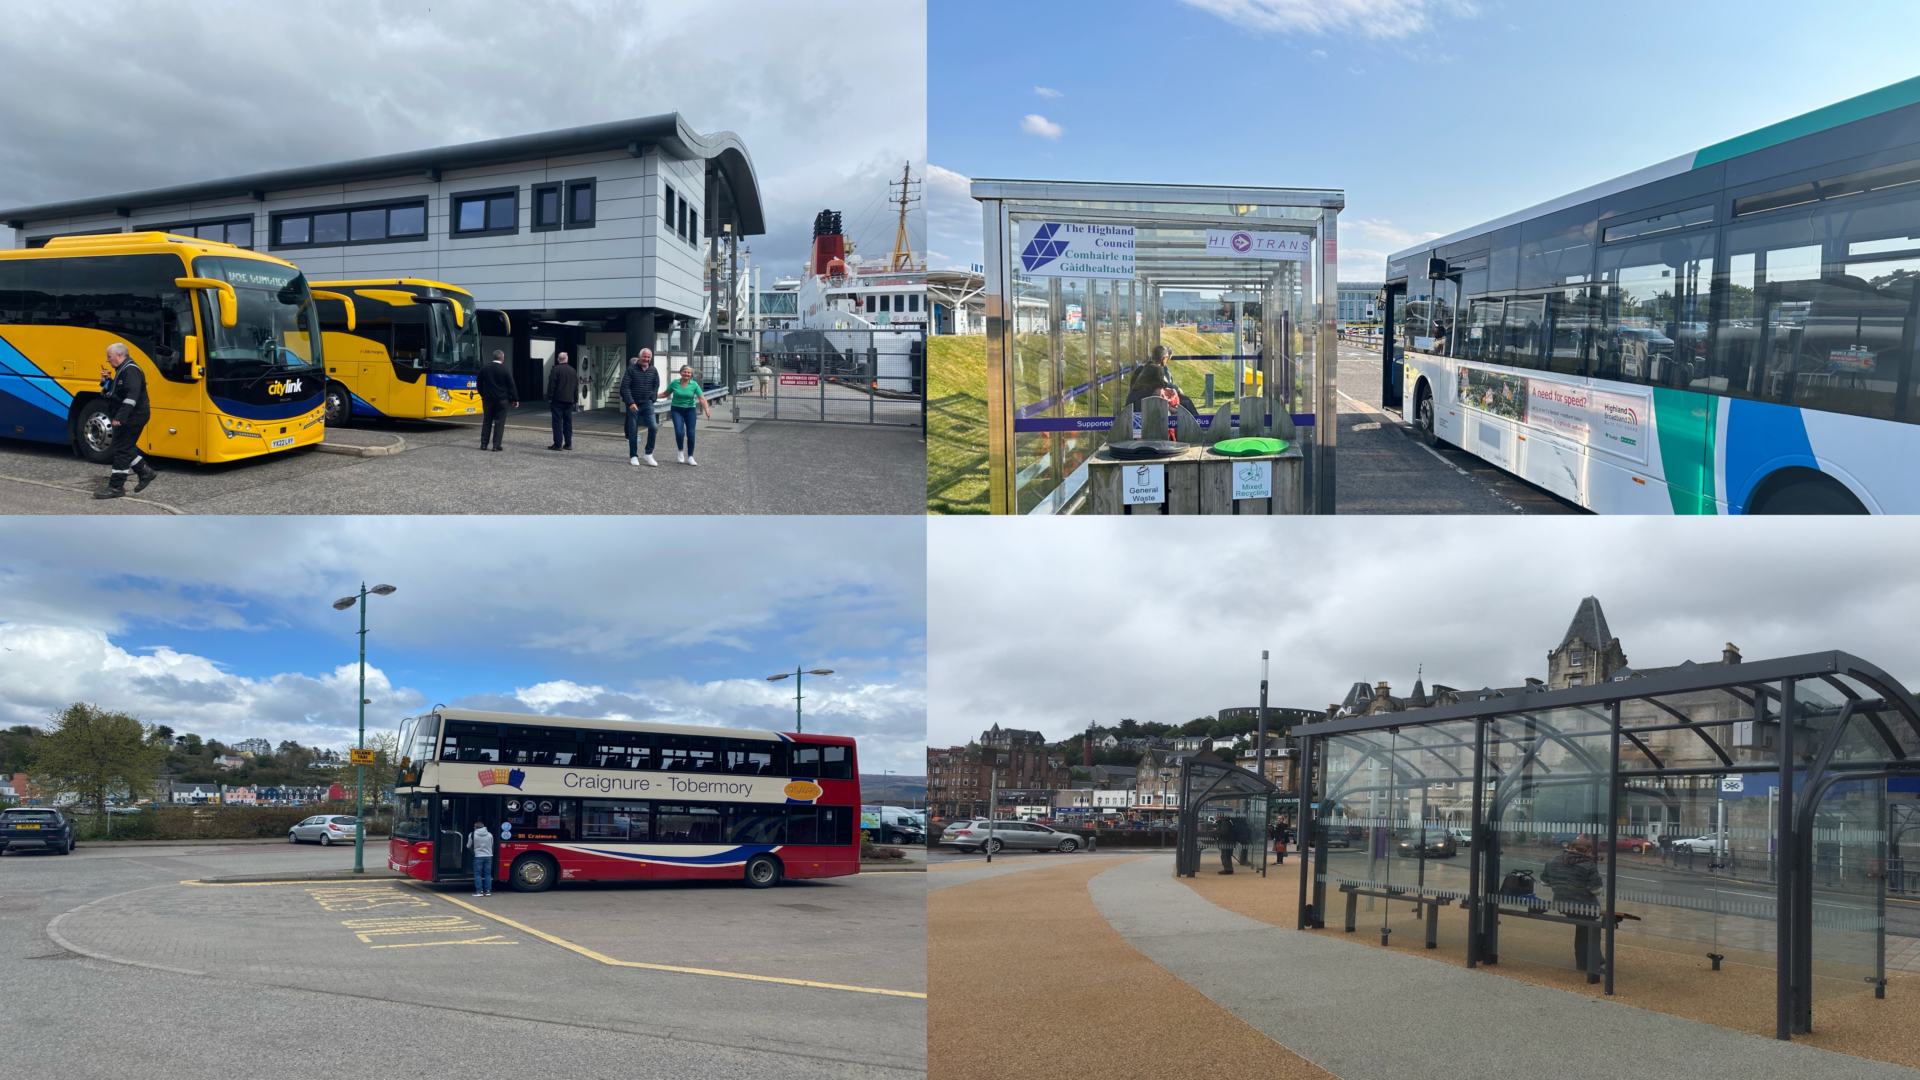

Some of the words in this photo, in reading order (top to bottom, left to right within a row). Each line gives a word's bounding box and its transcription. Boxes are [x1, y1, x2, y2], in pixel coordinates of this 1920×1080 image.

[1064, 223, 1084, 233] The
[1087, 225, 1134, 236] Highland
[1095, 238, 1134, 248] Council
[1208, 235, 1225, 245] HI
[1257, 238, 1309, 251] TRANS
[1064, 249, 1118, 261] Comhairle
[1060, 262, 1134, 274] Gàidhealtachd
[268, 378, 303, 396] citylink
[1532, 387, 1536, 397] A
[1538, 389, 1552, 400] need
[1554, 391, 1563, 402] for
[1564, 395, 1587, 408] speed?
[1604, 403, 1627, 414] Highland
[1604, 412, 1627, 423] Broadband
[1077, 420, 1113, 430] Supported
[1129, 486, 1159, 494] General
[563, 772, 650, 793] Craignure
[668, 776, 753, 797] Tobermory
[340, 915, 520, 949] ONLY
